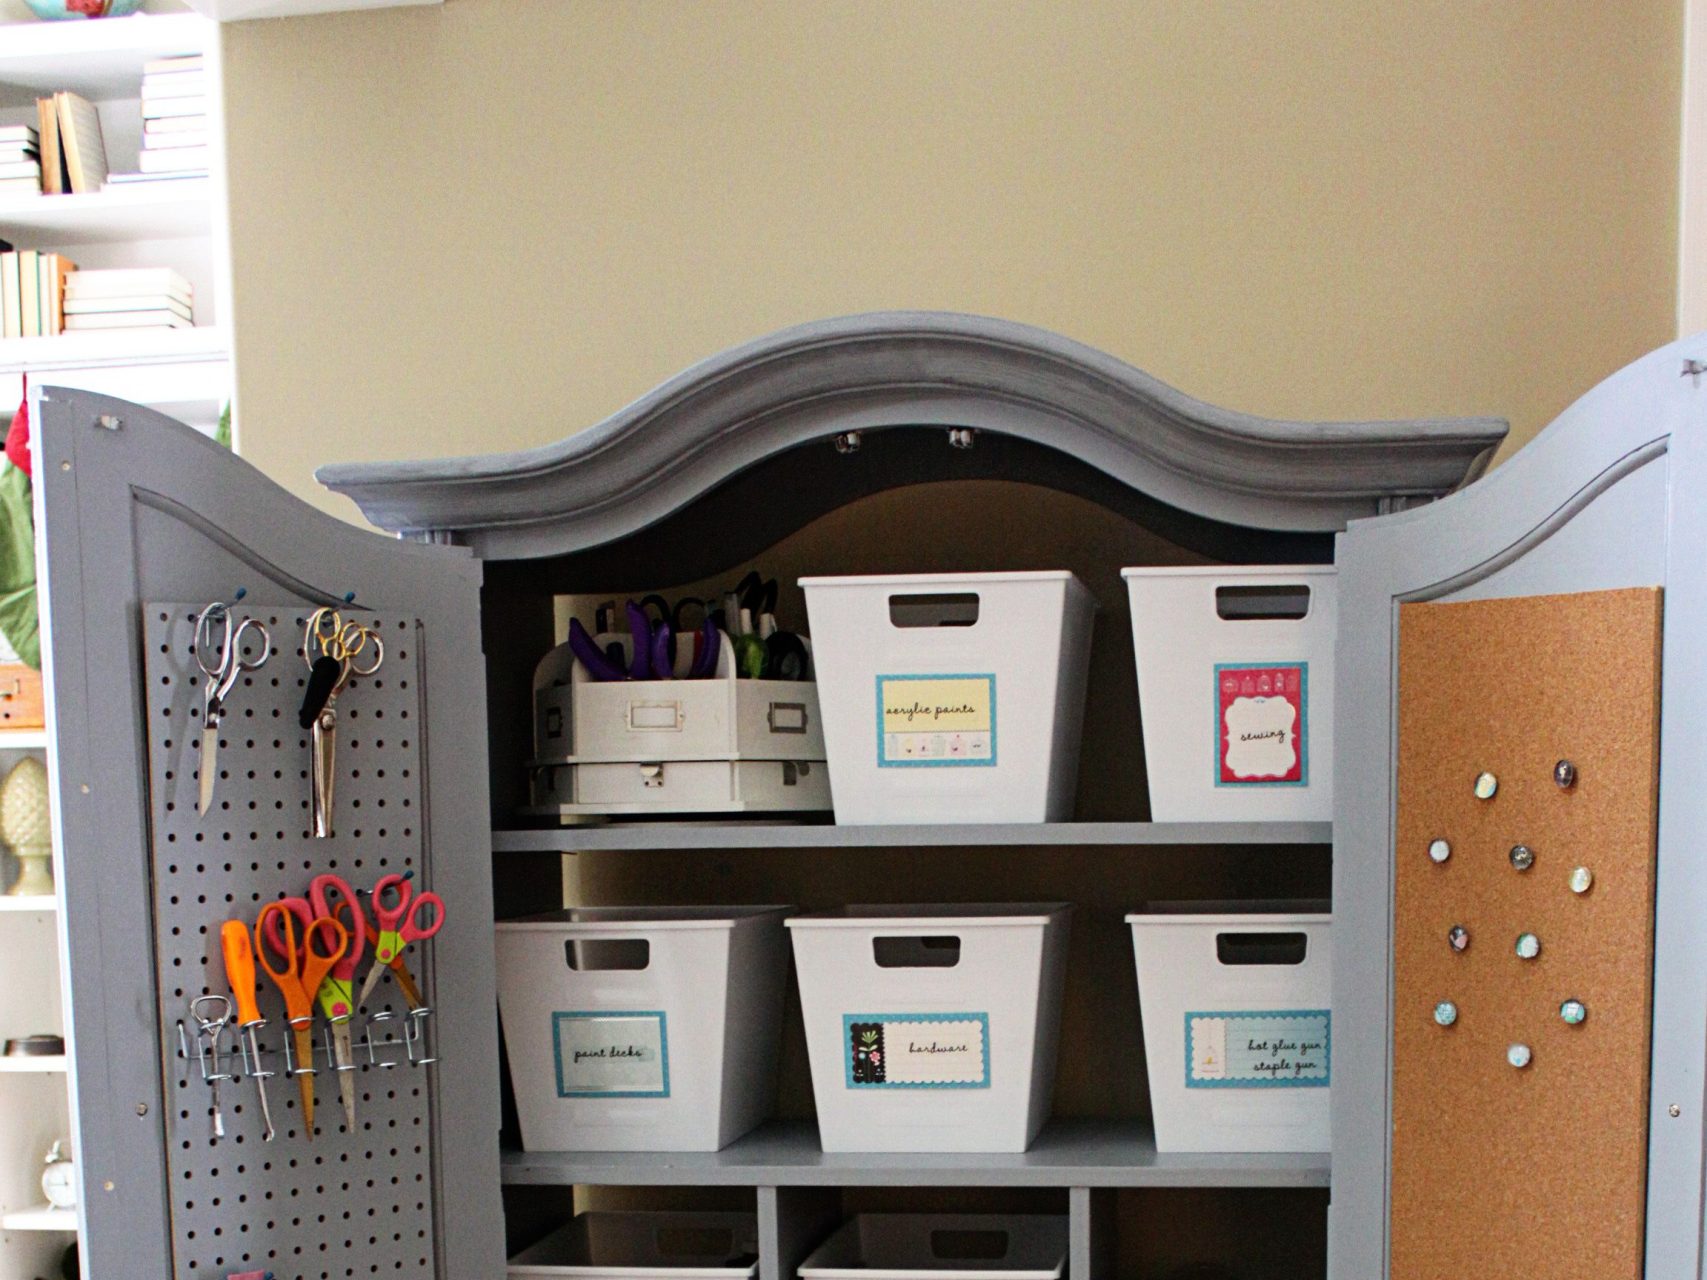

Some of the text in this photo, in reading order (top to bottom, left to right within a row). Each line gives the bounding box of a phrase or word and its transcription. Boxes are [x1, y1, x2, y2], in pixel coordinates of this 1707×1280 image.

[886, 702, 975, 721] acrylic paints
[1241, 730, 1285, 743] sewing
[909, 1042, 967, 1053] hardware
[1248, 1040, 1321, 1056] hot glue gun
[574, 1049, 606, 1063] paint
[1254, 1059, 1316, 1075] staple gun
